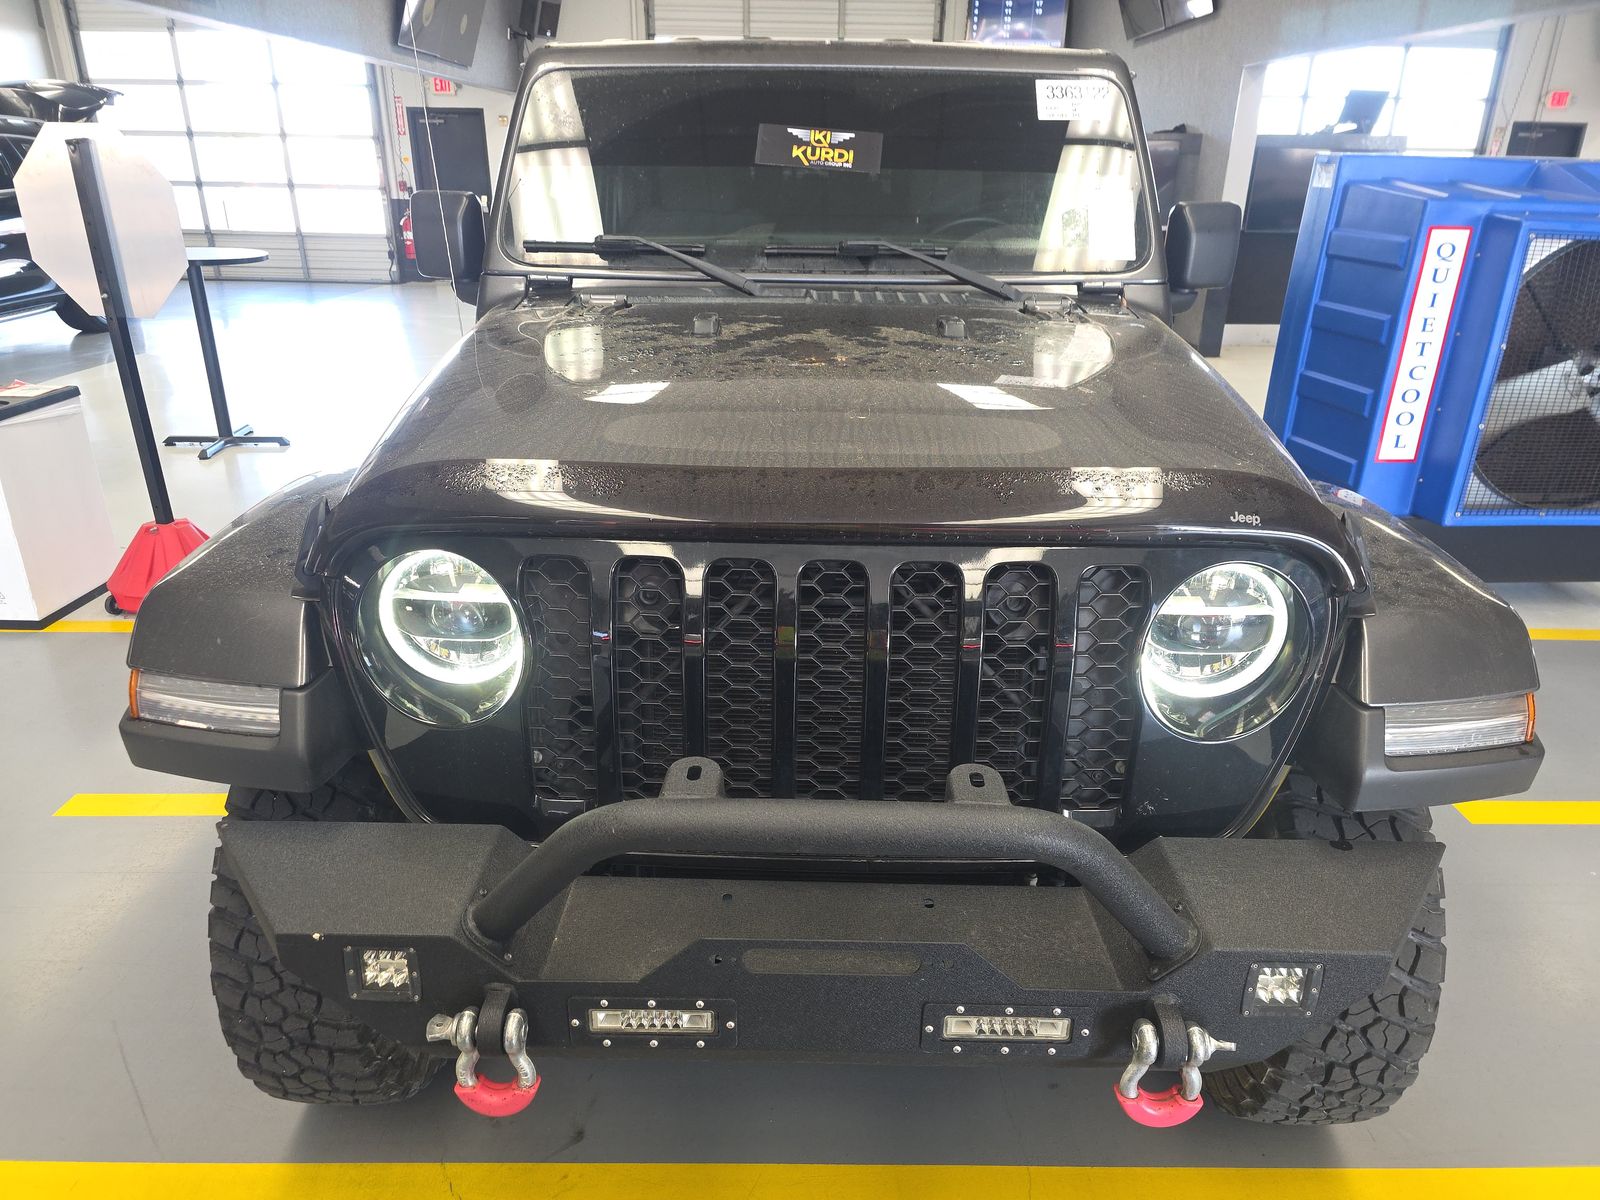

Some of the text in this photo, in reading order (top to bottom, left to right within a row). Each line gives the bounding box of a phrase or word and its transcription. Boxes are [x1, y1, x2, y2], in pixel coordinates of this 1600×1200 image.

[433, 77, 452, 93] EXIT
[792, 145, 855, 167] KURDI
[1393, 242, 1456, 449] QUIETCOOL
[1230, 511, 1261, 526] Jeep
